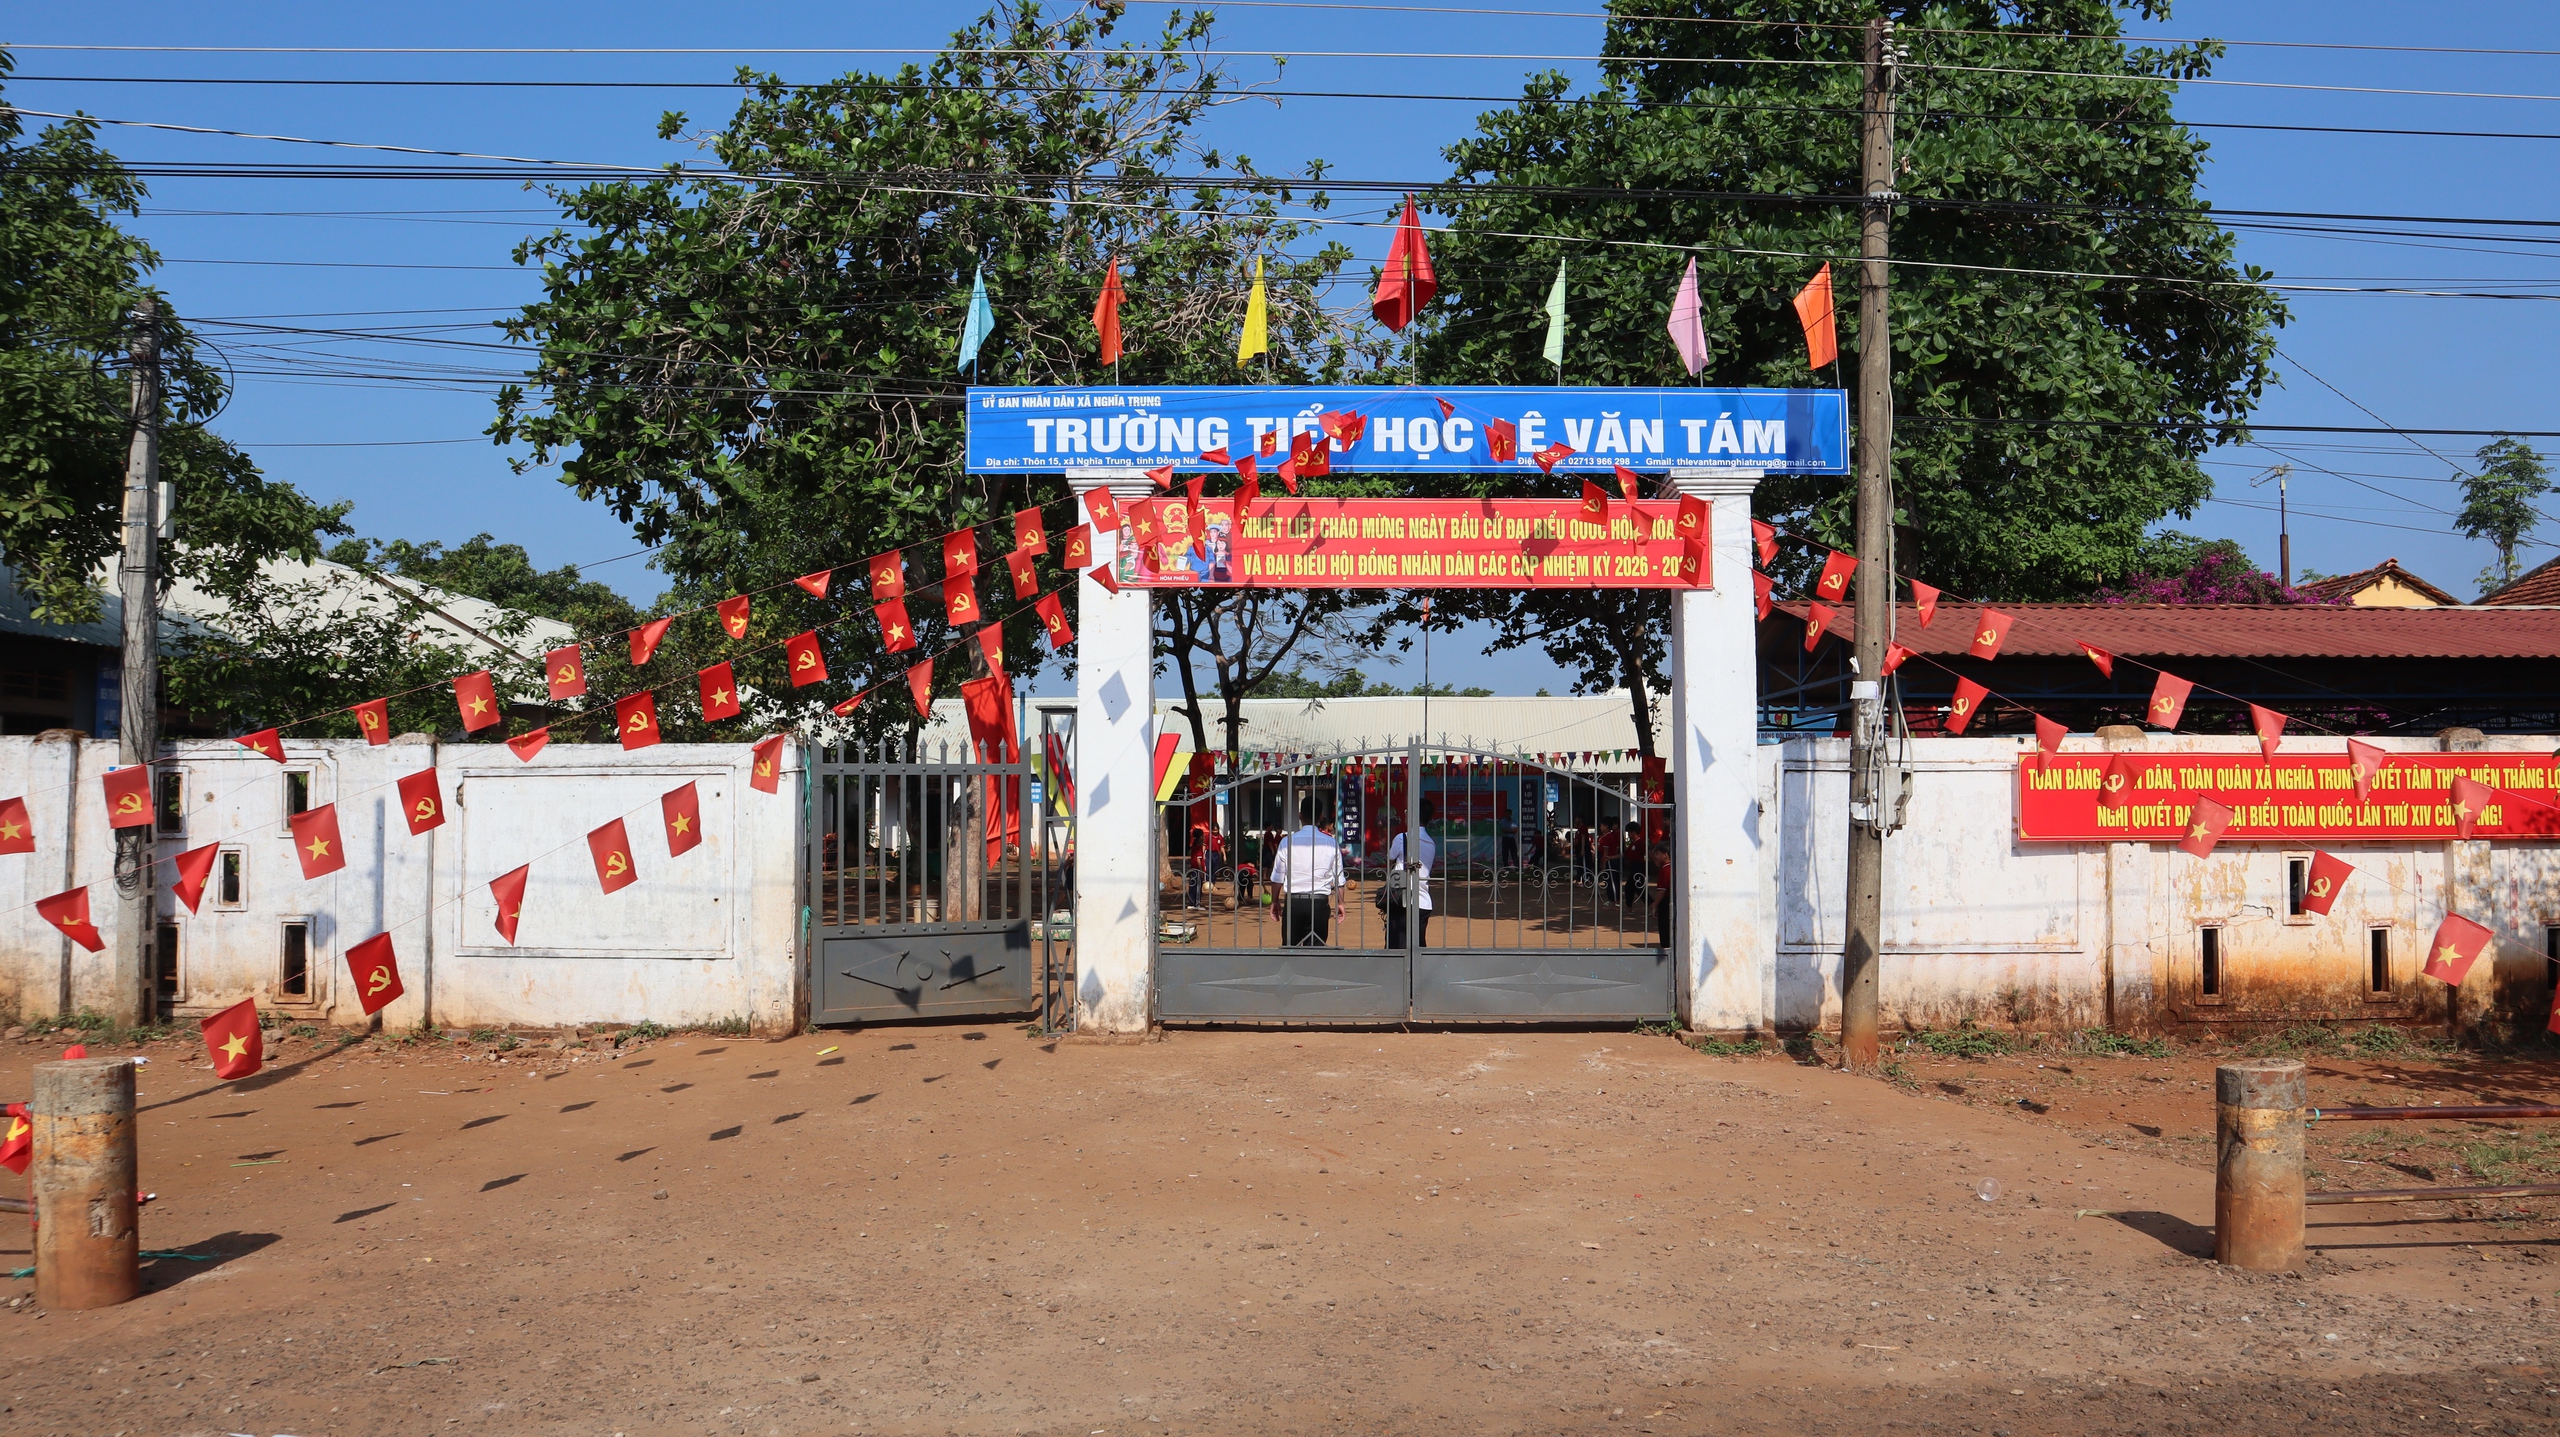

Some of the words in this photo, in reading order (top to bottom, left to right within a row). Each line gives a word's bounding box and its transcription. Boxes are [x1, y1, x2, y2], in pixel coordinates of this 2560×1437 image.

[998, 397, 1020, 408] BAN
[1022, 394, 1051, 408] NHÂN
[1053, 394, 1075, 408] DÂN
[1077, 394, 1092, 407] XÃ
[1093, 394, 1126, 407] NGHĨA
[1127, 396, 1162, 407] TRUNG
[1026, 408, 1229, 453] TRƯỜNG
[1373, 417, 1474, 460] HỌC
[1563, 411, 1665, 453] VĂN
[1680, 412, 1786, 454] TÁM
[986, 457, 1001, 468] Địa
[1022, 457, 1046, 466] Thôn
[1048, 457, 1061, 467] 15,
[1063, 457, 1075, 466] xã
[1076, 456, 1103, 467] Nghĩa
[1105, 456, 1134, 467] Trung,
[1136, 456, 1154, 466] tỉnh
[1156, 455, 1181, 467] Đồng
[1183, 456, 1198, 466] Nai
[1568, 457, 1595, 466] 02713
[1597, 457, 1613, 466] 966
[1614, 457, 1631, 466] 298
[1645, 457, 1675, 466] Gmail:
[1677, 457, 1827, 468] thlevantamnghiatrung@gmail.com
[1242, 512, 1284, 543] NHIỆT
[1287, 512, 1317, 543] LIỆT
[1320, 512, 1358, 539] CHÀO
[1362, 512, 1405, 539] MỪNG
[1408, 512, 1447, 539] NGÀY
[1450, 510, 1479, 539] BẦU
[1483, 510, 1504, 539] CỬ
[1506, 518, 1530, 544] ĐẠI
[1533, 509, 1566, 540] BIỂU
[1243, 549, 1262, 576] VÀ
[1265, 554, 1290, 581] ĐẠI
[1293, 545, 1326, 576] BIỂU
[1330, 549, 1354, 581] HỘI
[1358, 547, 1397, 576] ĐỒNG
[1401, 549, 1441, 576] NHÂN
[1445, 549, 1475, 576] DÂN
[1478, 550, 1507, 577] CÁC
[1511, 547, 1540, 577] CẤP
[1543, 550, 1589, 582] NHIỆM
[1593, 551, 1611, 577] KỲ
[1614, 555, 1649, 577] 2026
[2065, 760, 2102, 790] ĐẢNG
[2145, 763, 2177, 792] DÂN,
[2179, 763, 2213, 790] TOÀN
[2216, 763, 2252, 792] QUÂN
[2255, 763, 2273, 790] XÃ
[2275, 764, 2316, 790] NGHĨA
[2317, 768, 2355, 790] TRUN
[2367, 761, 2402, 792] UYẾT
[2404, 763, 2433, 790] TÂM
[2502, 760, 2545, 789] THẮNG
[2097, 805, 2129, 832] NGHỊ
[2131, 798, 2172, 829] QUYẾT
[2249, 796, 2279, 827] BIỂU
[2281, 800, 2316, 827] TOÀN
[2318, 797, 2353, 829] QUỐC
[2356, 797, 2381, 827] LẦN
[2383, 800, 2409, 827] THỨ
[2411, 805, 2432, 827] XIV
